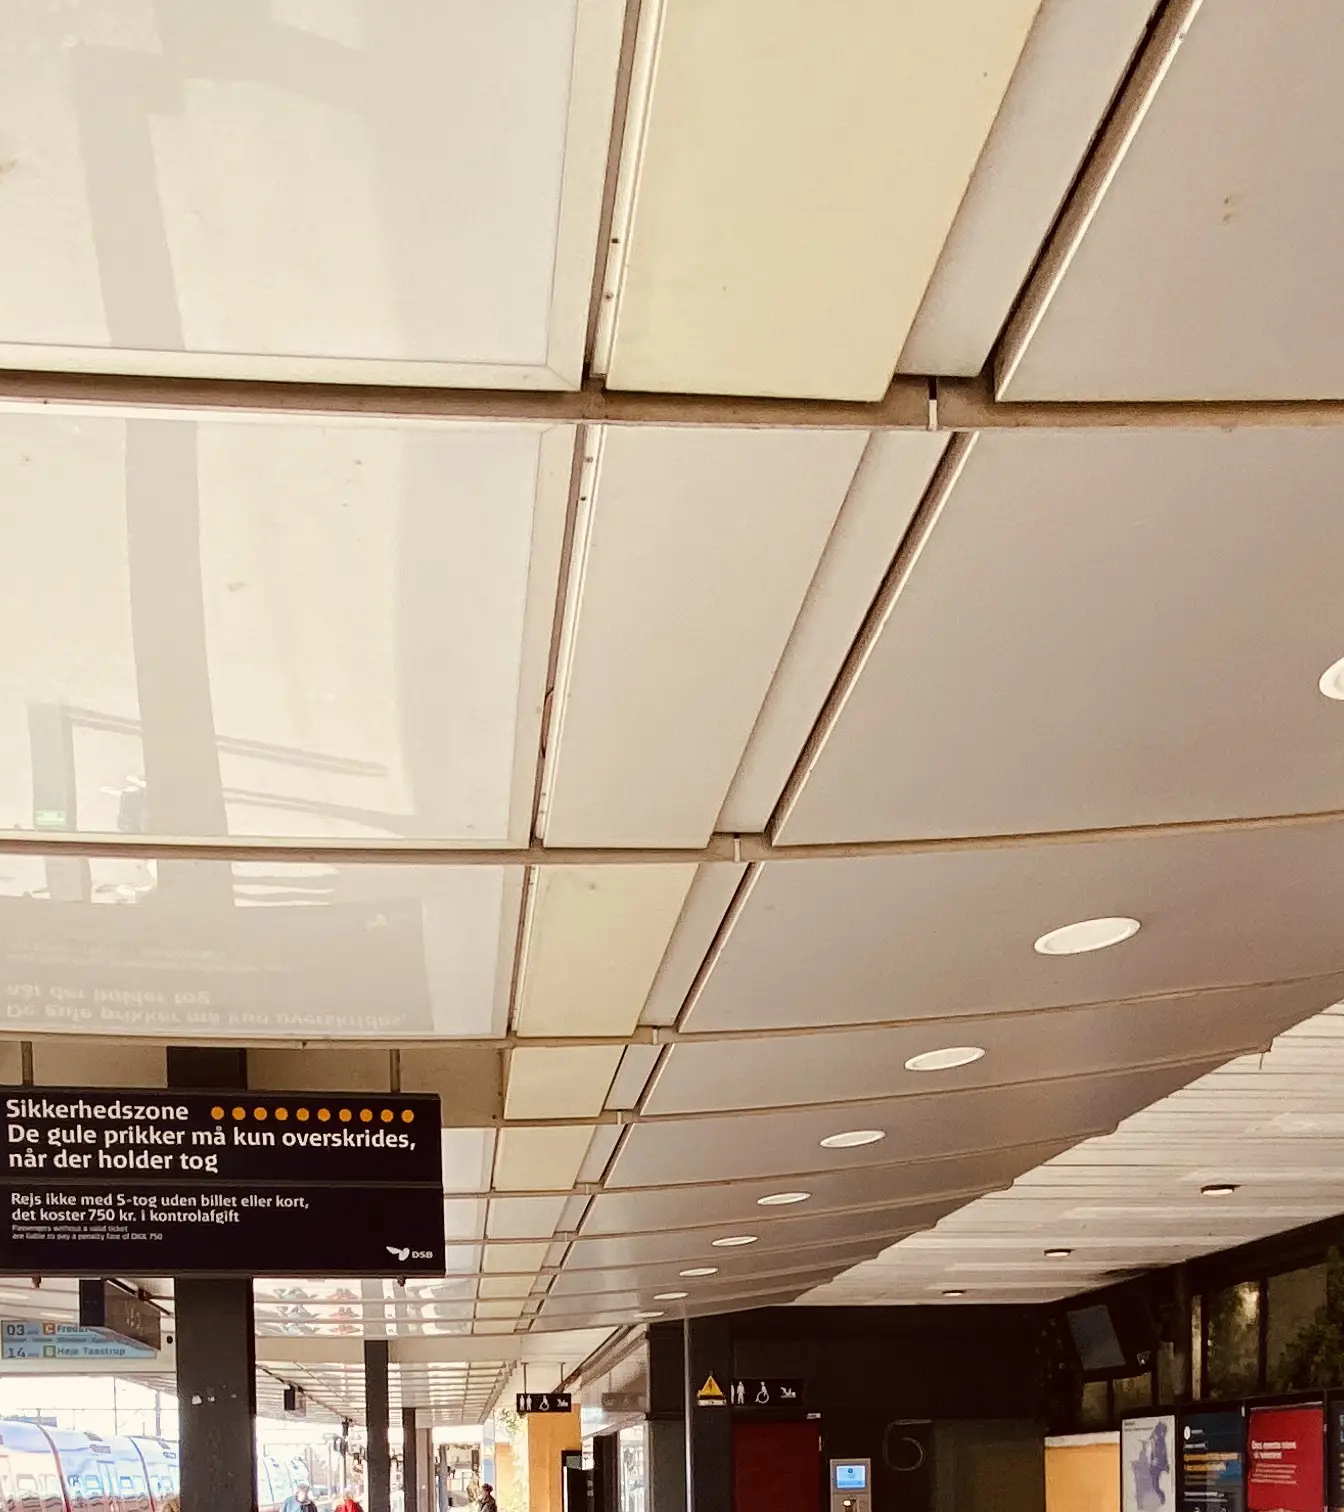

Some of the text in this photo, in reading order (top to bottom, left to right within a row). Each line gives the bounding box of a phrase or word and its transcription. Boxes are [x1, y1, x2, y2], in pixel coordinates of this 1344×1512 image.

[6, 1099, 189, 1121] Sikkerhedszone
[8, 1124, 416, 1151] De gule prikker må kun overskrides,
[9, 1147, 218, 1173] når der holder tog
[11, 1192, 309, 1209] Rejs ikke med S-tog uden billet eller kort,
[11, 1208, 240, 1225] det koster 750 kr. i kontrolafgift
[411, 1250, 434, 1259] DSB
[6, 1324, 25, 1336] 03
[7, 1347, 26, 1358] 14
